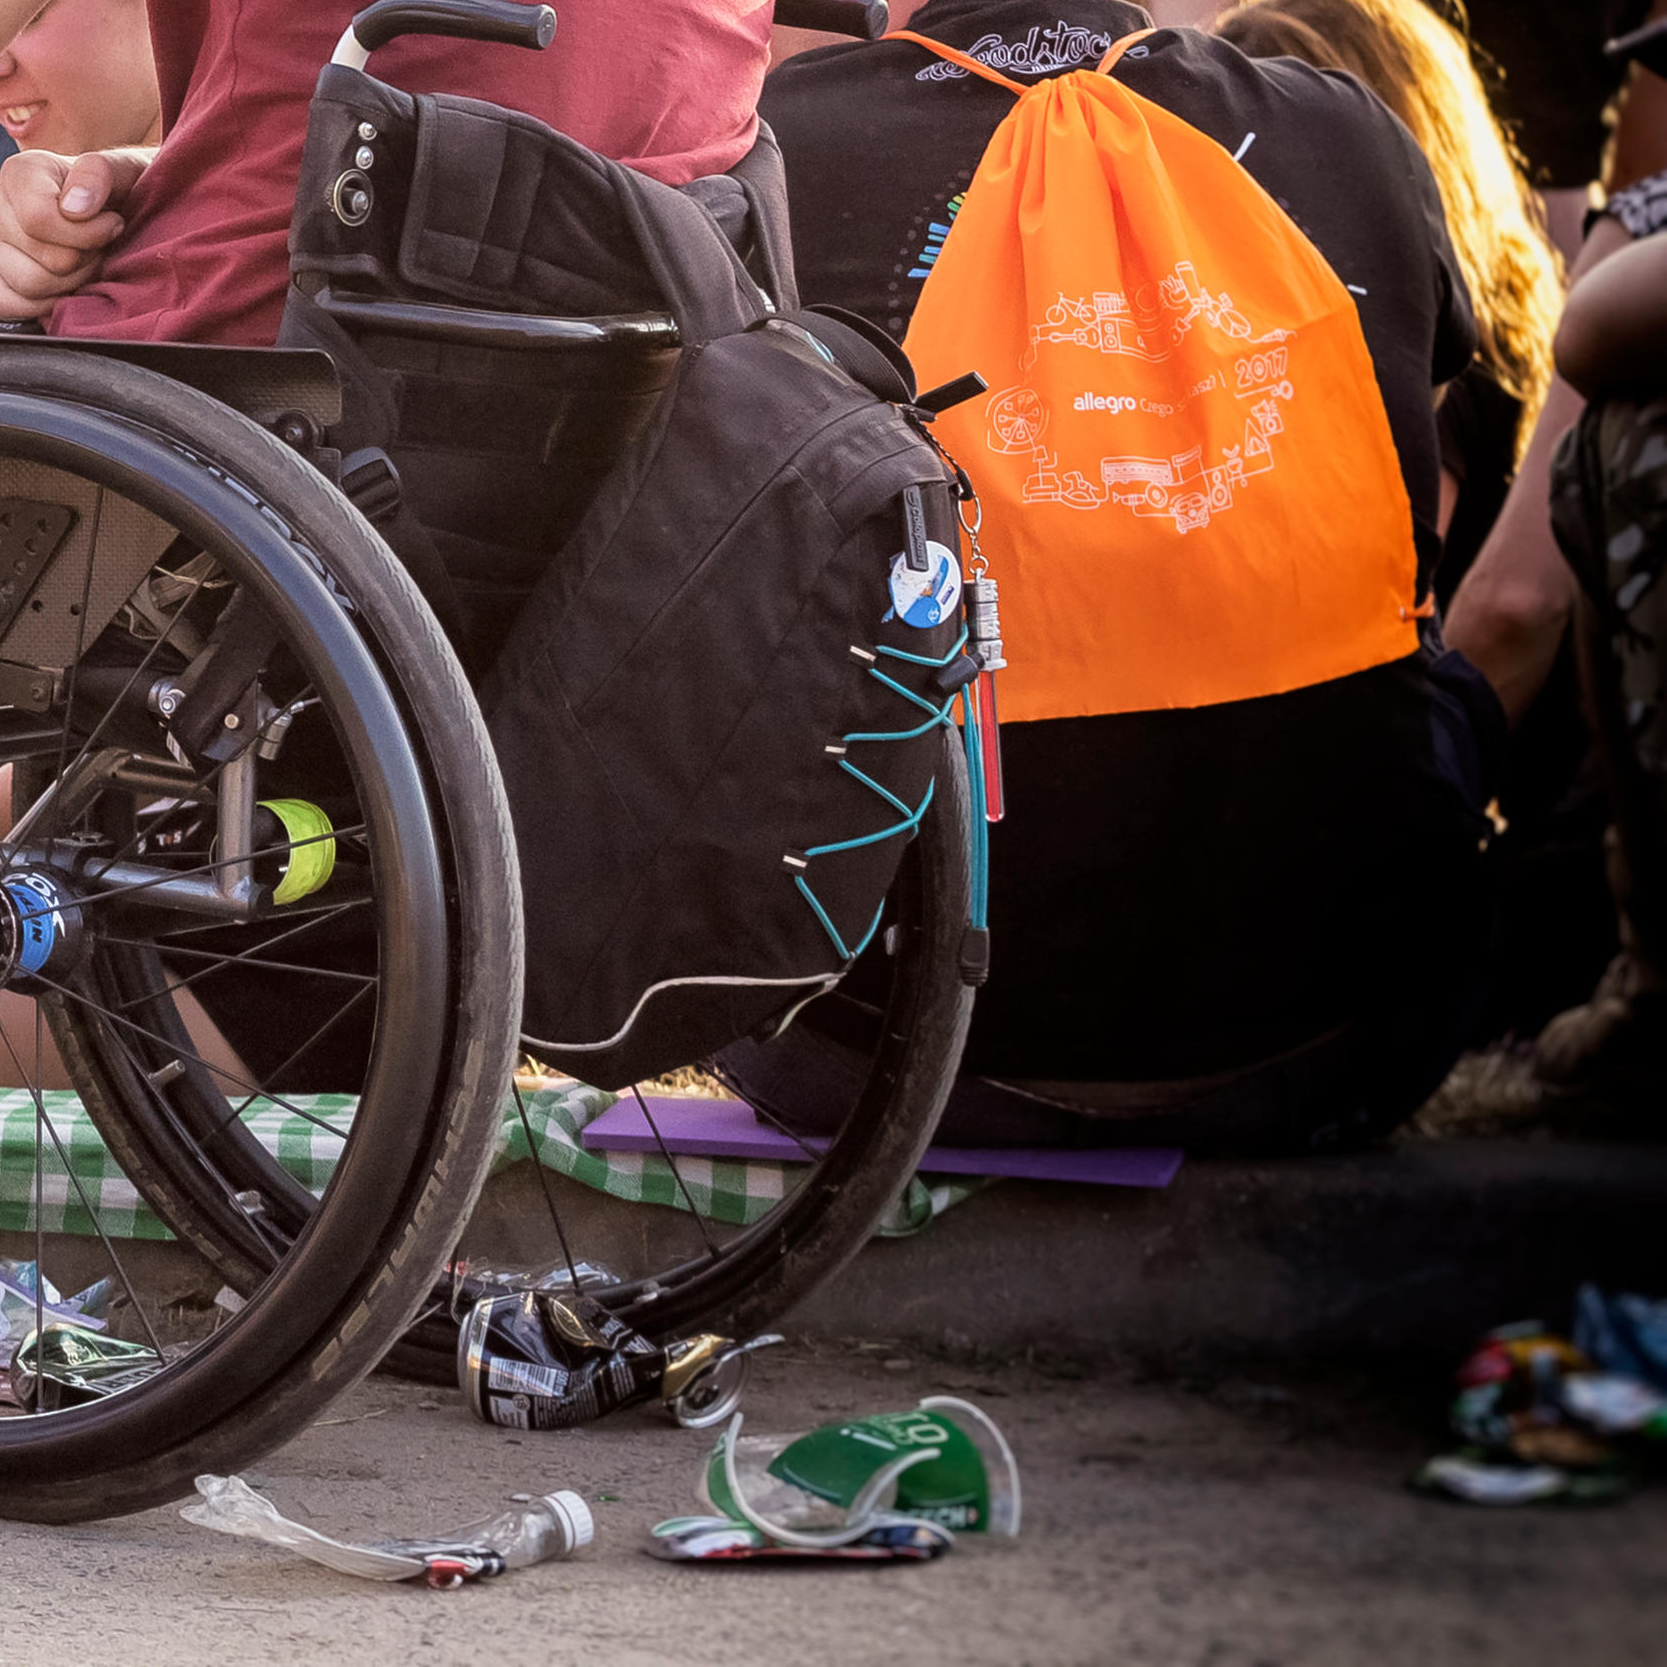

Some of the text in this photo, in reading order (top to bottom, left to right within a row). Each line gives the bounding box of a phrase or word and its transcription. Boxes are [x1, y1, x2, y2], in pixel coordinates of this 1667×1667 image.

[1234, 347, 1289, 388] 2017
[1073, 391, 1137, 415] allegro
[1139, 398, 1175, 417] Czego
